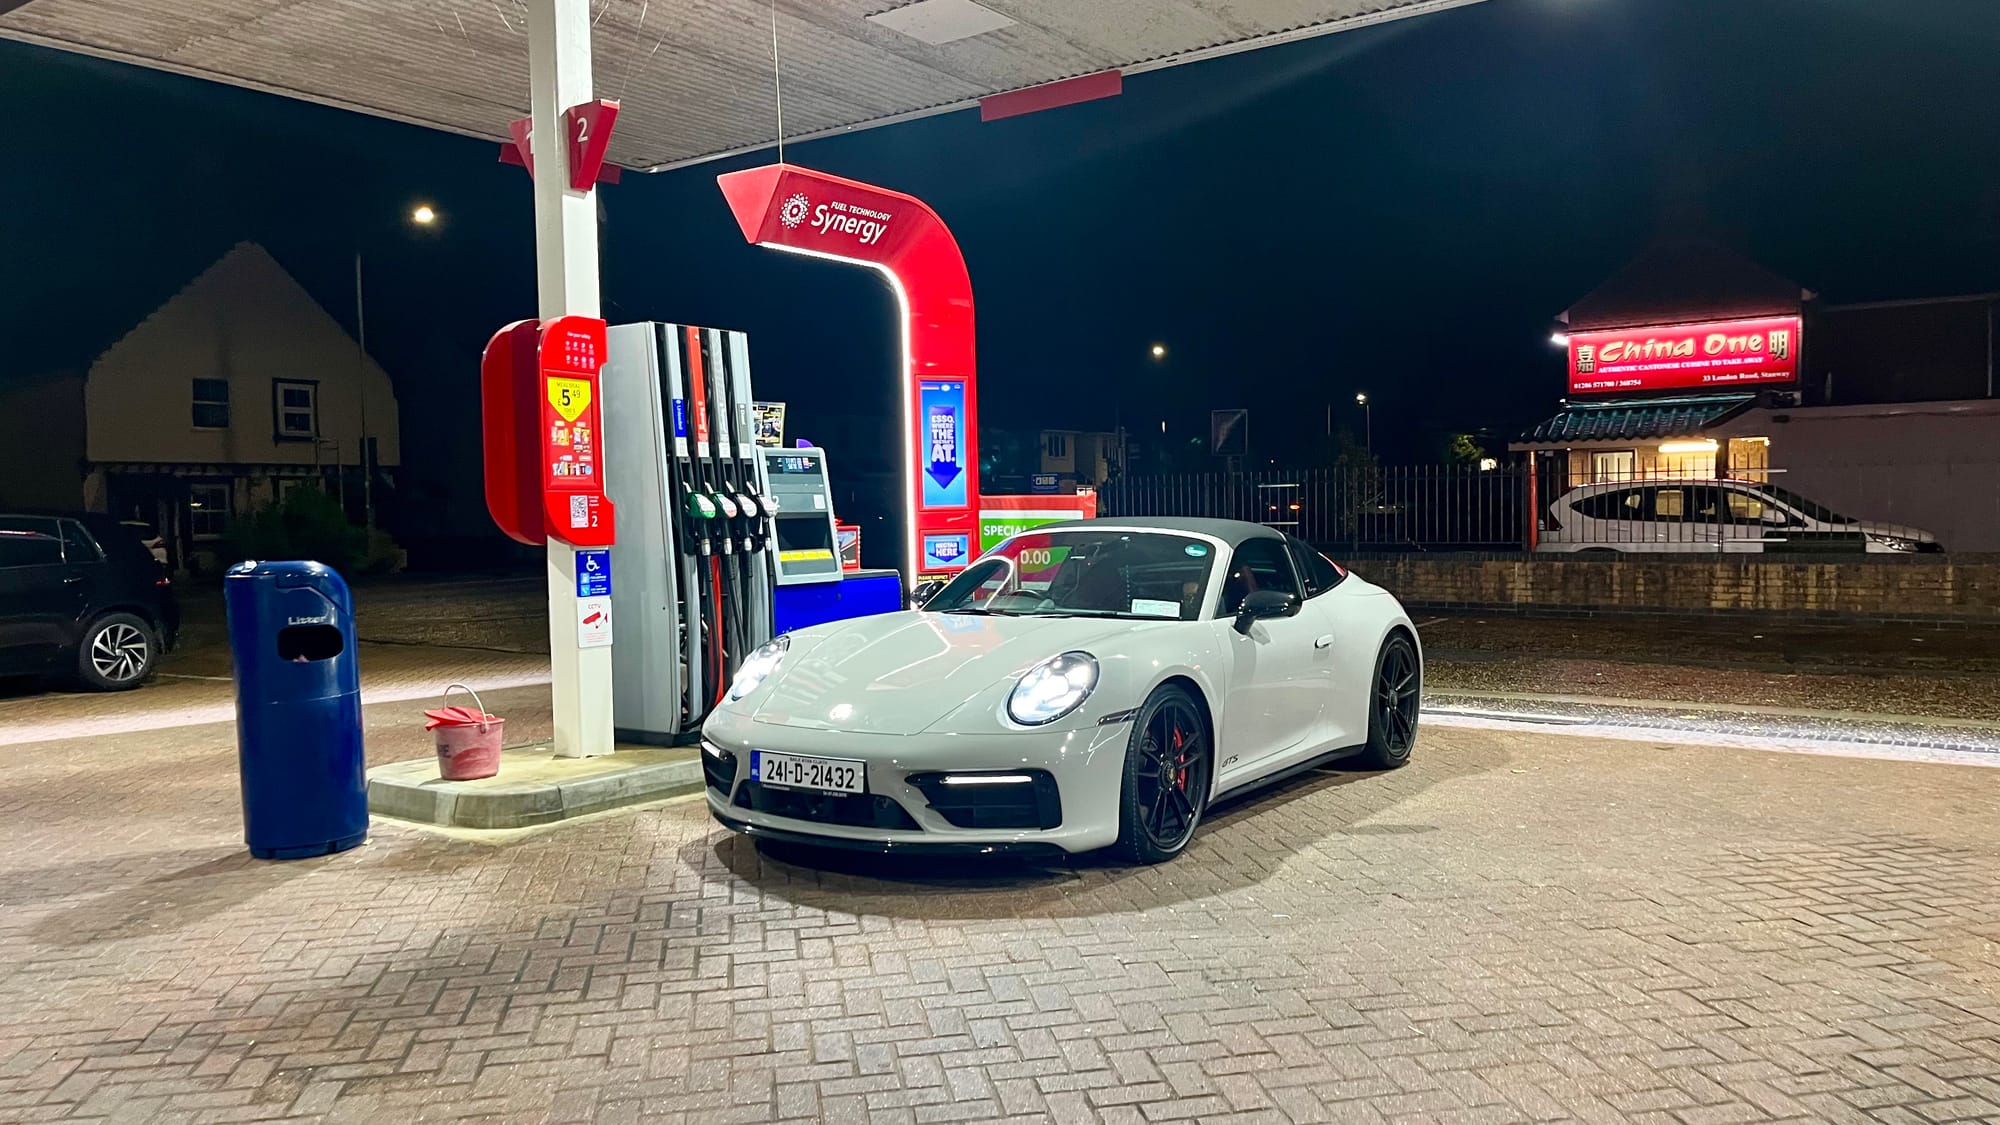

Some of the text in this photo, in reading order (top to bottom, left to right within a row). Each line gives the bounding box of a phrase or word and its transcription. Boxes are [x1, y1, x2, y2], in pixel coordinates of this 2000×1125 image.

[576, 117, 589, 143] 2
[830, 201, 892, 222] FUEL TECHNOLOGY
[810, 204, 887, 245] Synergy
[1599, 333, 1763, 363] China One
[1768, 330, 1789, 360] 明
[1712, 373, 1738, 381] London
[932, 429, 954, 440] THE
[931, 444, 956, 463] AT.
[591, 515, 599, 527] 2
[935, 547, 957, 556] HERE
[766, 759, 855, 790] 241-D-21432
